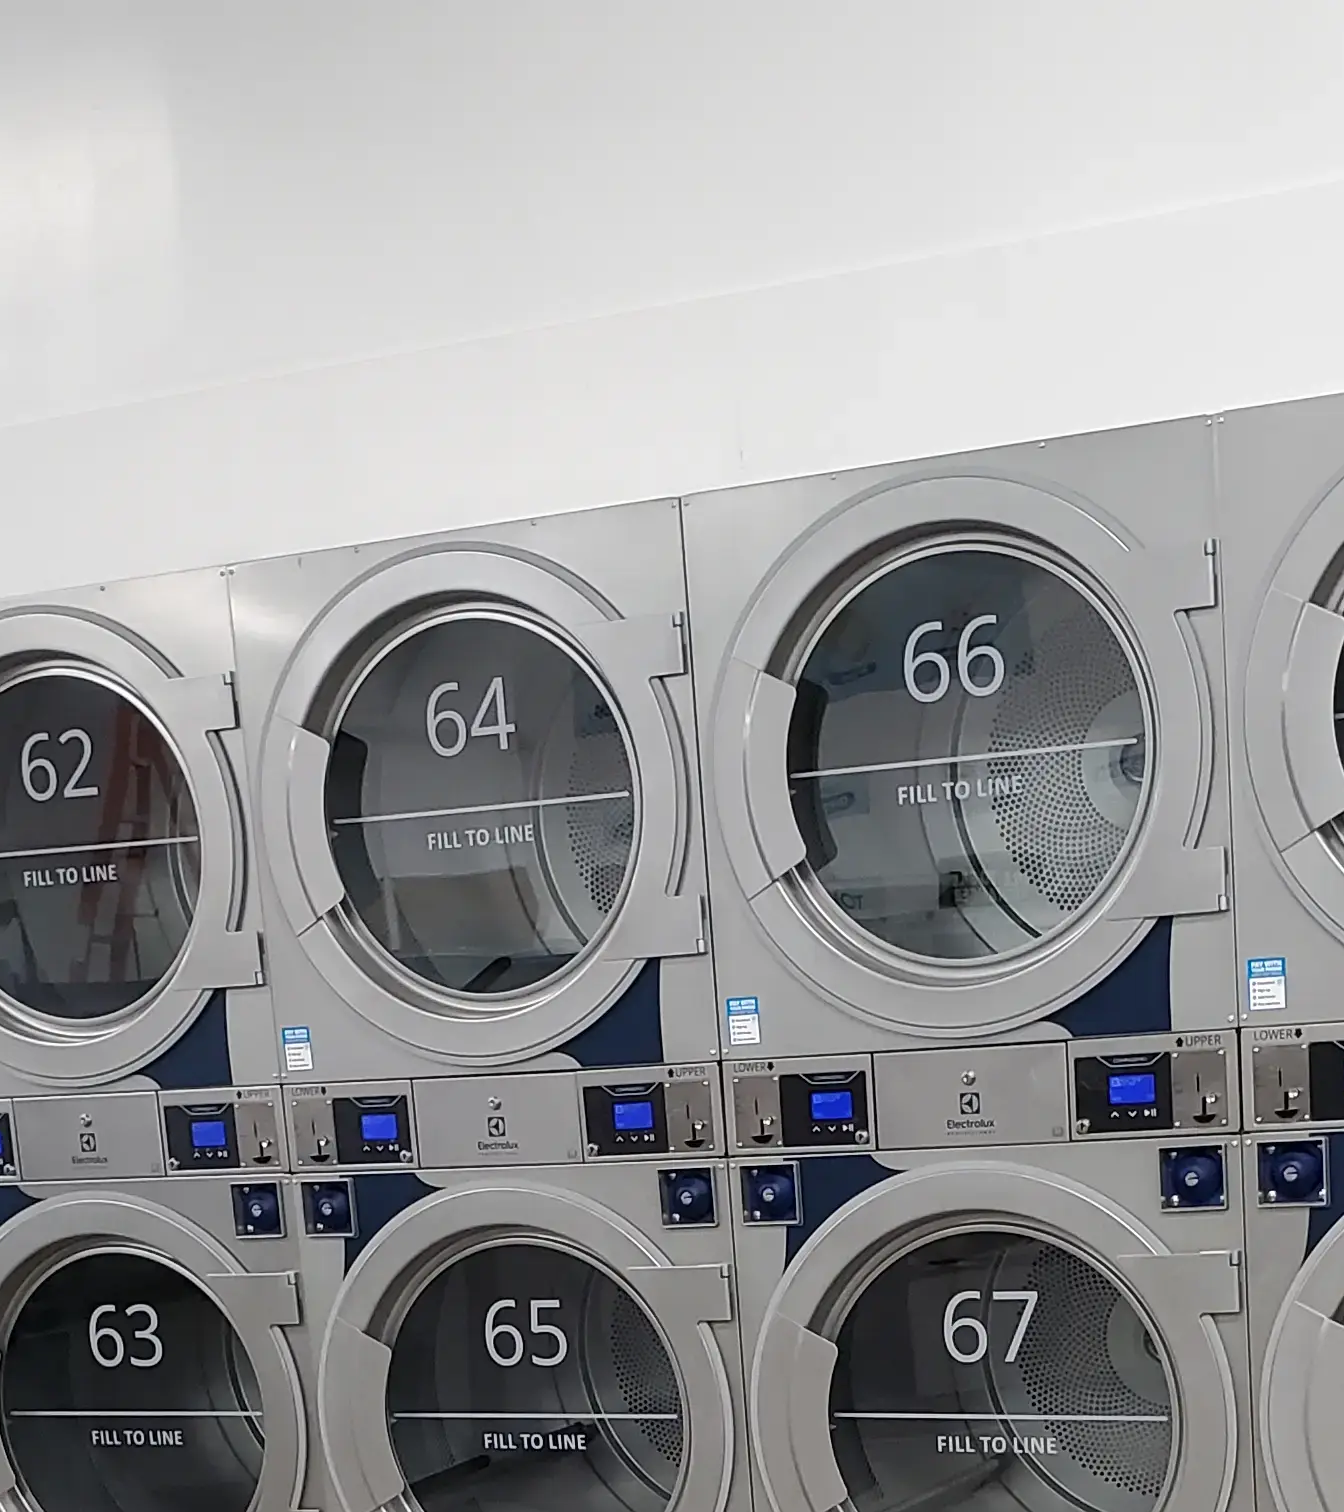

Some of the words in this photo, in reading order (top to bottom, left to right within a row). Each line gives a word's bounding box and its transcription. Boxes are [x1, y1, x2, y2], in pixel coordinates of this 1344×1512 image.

[903, 614, 1005, 703] 66
[426, 676, 516, 757] 64
[21, 728, 99, 802] 62
[898, 784, 937, 805] FILL
[941, 781, 970, 800] TO
[977, 775, 1022, 797] LINE
[427, 832, 462, 850] FILL
[464, 829, 489, 847] TO
[495, 824, 535, 845] LINE
[23, 870, 54, 887] FILL
[55, 867, 78, 885] TO
[82, 864, 118, 883] LINE
[1185, 1034, 1221, 1047] UPPER
[1253, 1028, 1293, 1041] LOWER
[733, 1062, 766, 1073] LOWER
[946, 1119, 995, 1130] Electrolux
[89, 1303, 163, 1367] 63
[485, 1299, 568, 1367] 65
[943, 1290, 1038, 1363] 67
[91, 1430, 122, 1445] FILL
[123, 1430, 145, 1446] TO
[149, 1430, 183, 1446] LINE
[484, 1433, 517, 1449] FILL
[519, 1434, 544, 1450] TO
[548, 1434, 587, 1450] LINE
[937, 1436, 975, 1453] FILL
[979, 1436, 1006, 1453] TO
[1013, 1437, 1058, 1454] LINE
